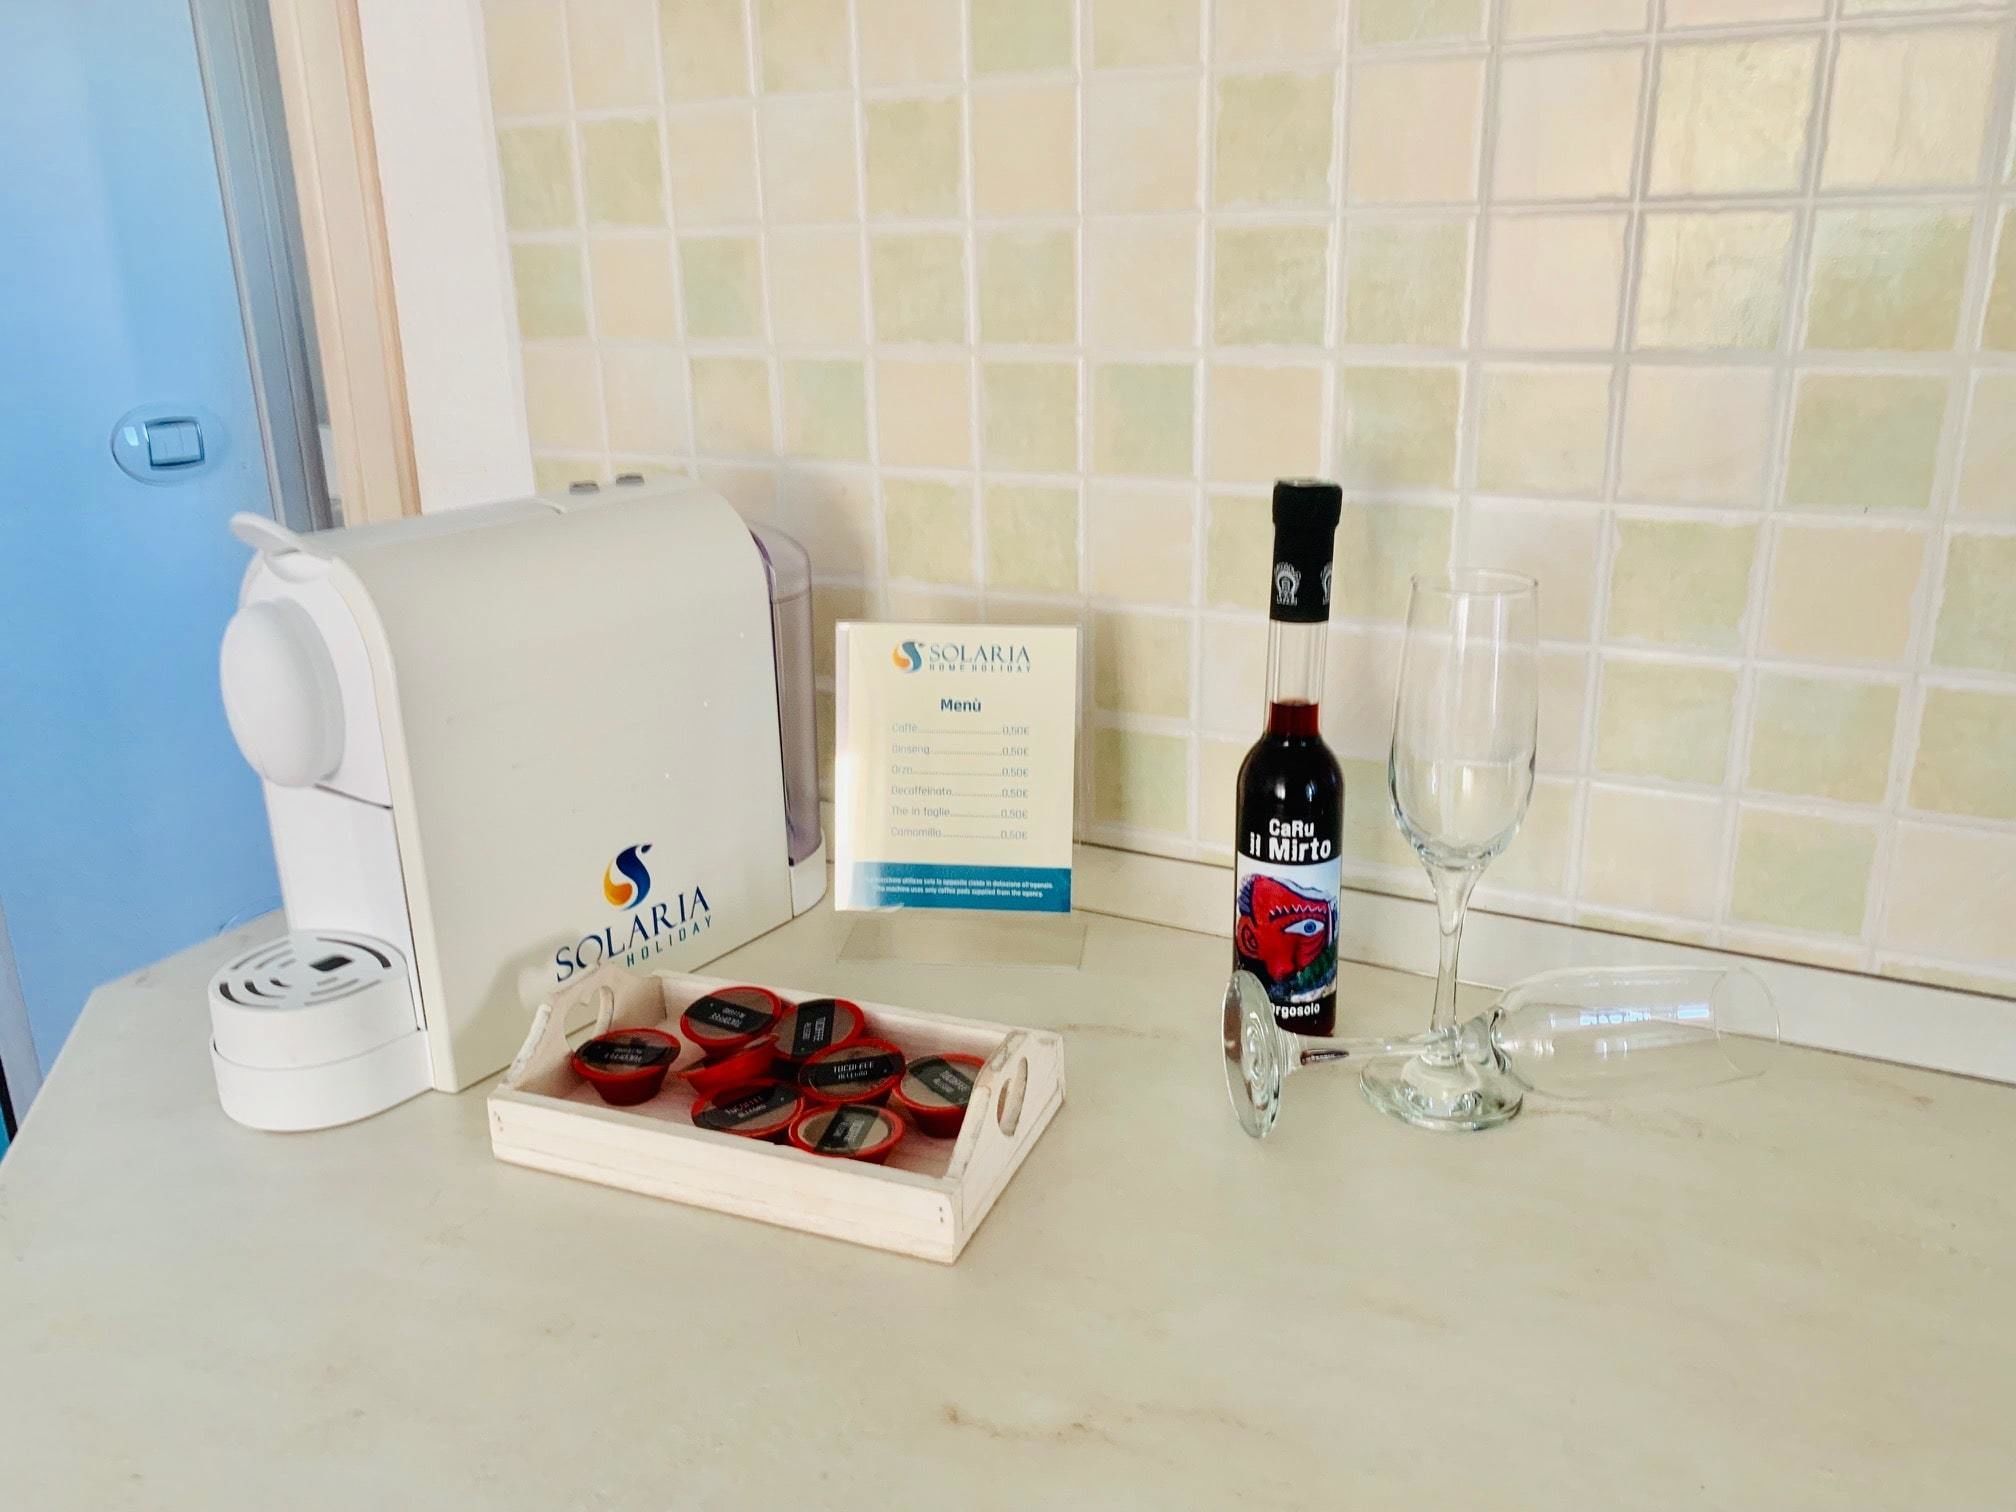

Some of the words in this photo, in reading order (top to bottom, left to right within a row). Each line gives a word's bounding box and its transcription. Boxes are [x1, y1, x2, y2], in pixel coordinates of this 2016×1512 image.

[929, 644, 1031, 663] SOLARIA
[929, 664, 967, 672] HOME
[971, 664, 1031, 673] HOLIDAY
[940, 697, 982, 712] Menù
[891, 785, 952, 796] Decaffeinato
[890, 827, 942, 838] Camomilla
[1269, 818, 1315, 838] CaRu
[1250, 832, 1261, 857] il
[1269, 837, 1332, 862] Mirto
[556, 886, 710, 983] SOLARIA
[626, 914, 712, 968] HOLIDAY
